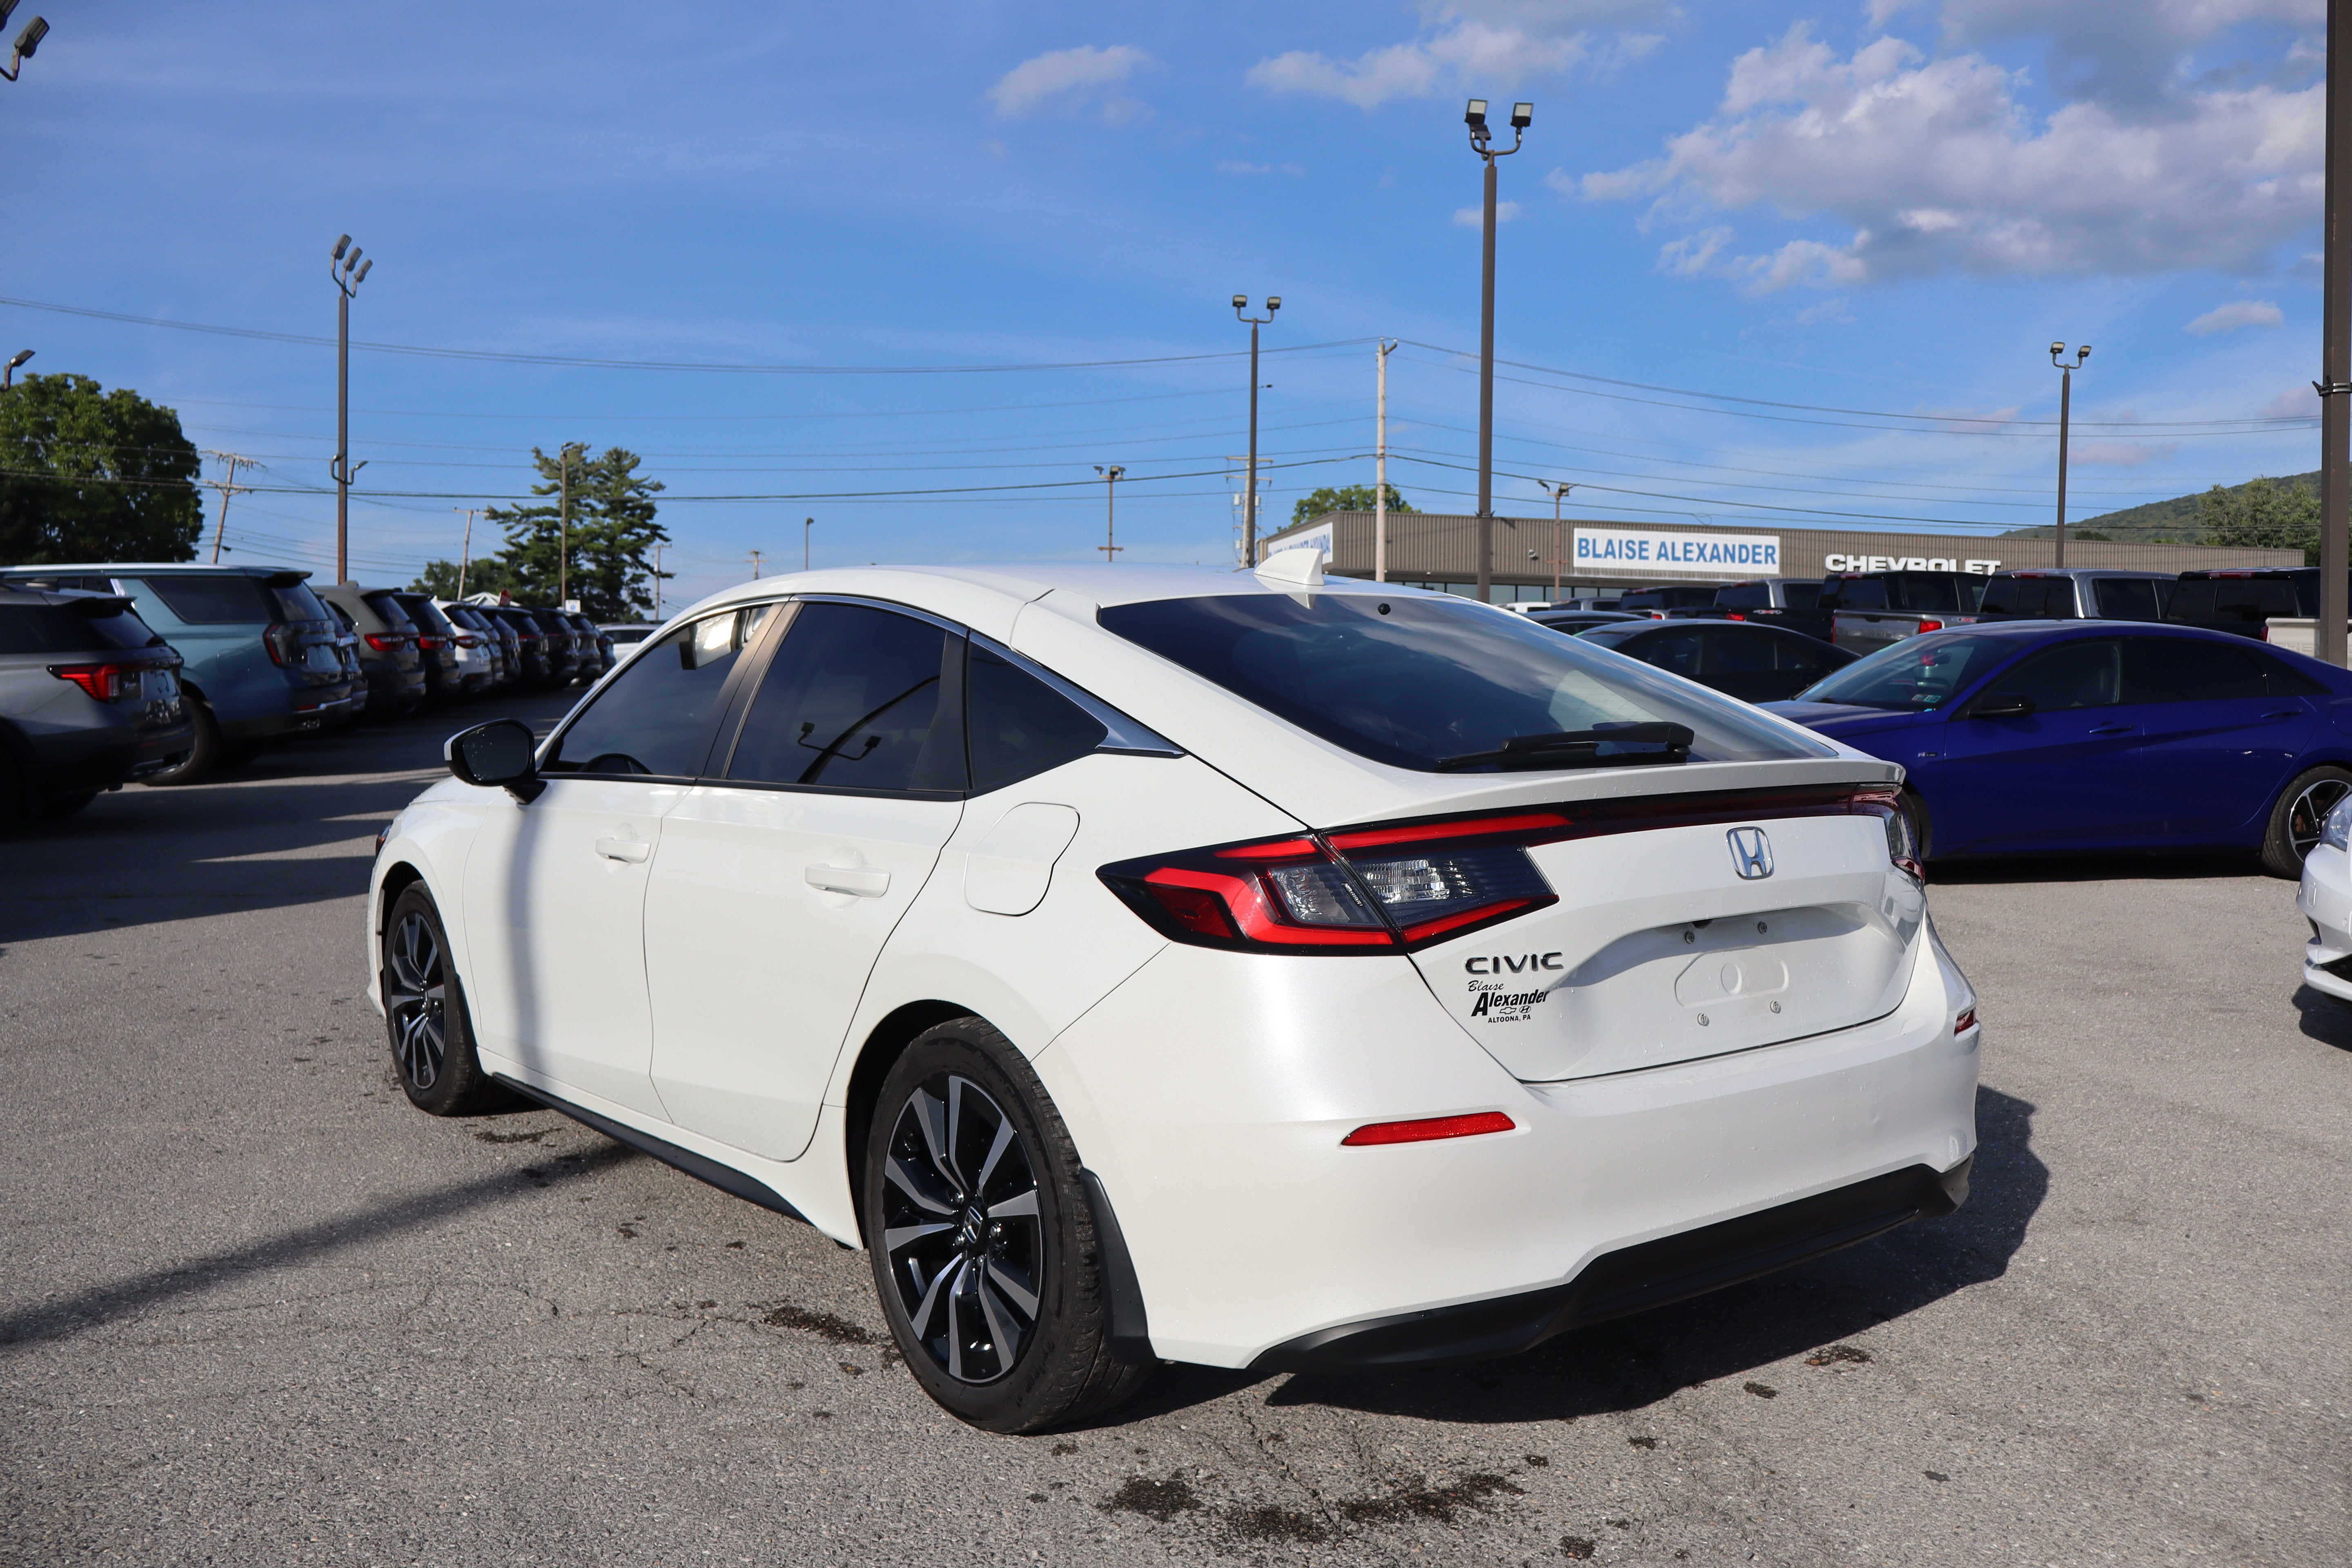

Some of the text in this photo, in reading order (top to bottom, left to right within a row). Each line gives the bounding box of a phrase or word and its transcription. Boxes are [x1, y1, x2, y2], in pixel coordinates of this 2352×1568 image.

[1578, 538, 1777, 565] BLAISE ALEXANDER
[1825, 554, 2001, 575] CHEVROLET
[1464, 952, 1564, 975] CIVIC
[1468, 980, 1504, 992] Blaise
[1470, 989, 1550, 1017] Alexander
